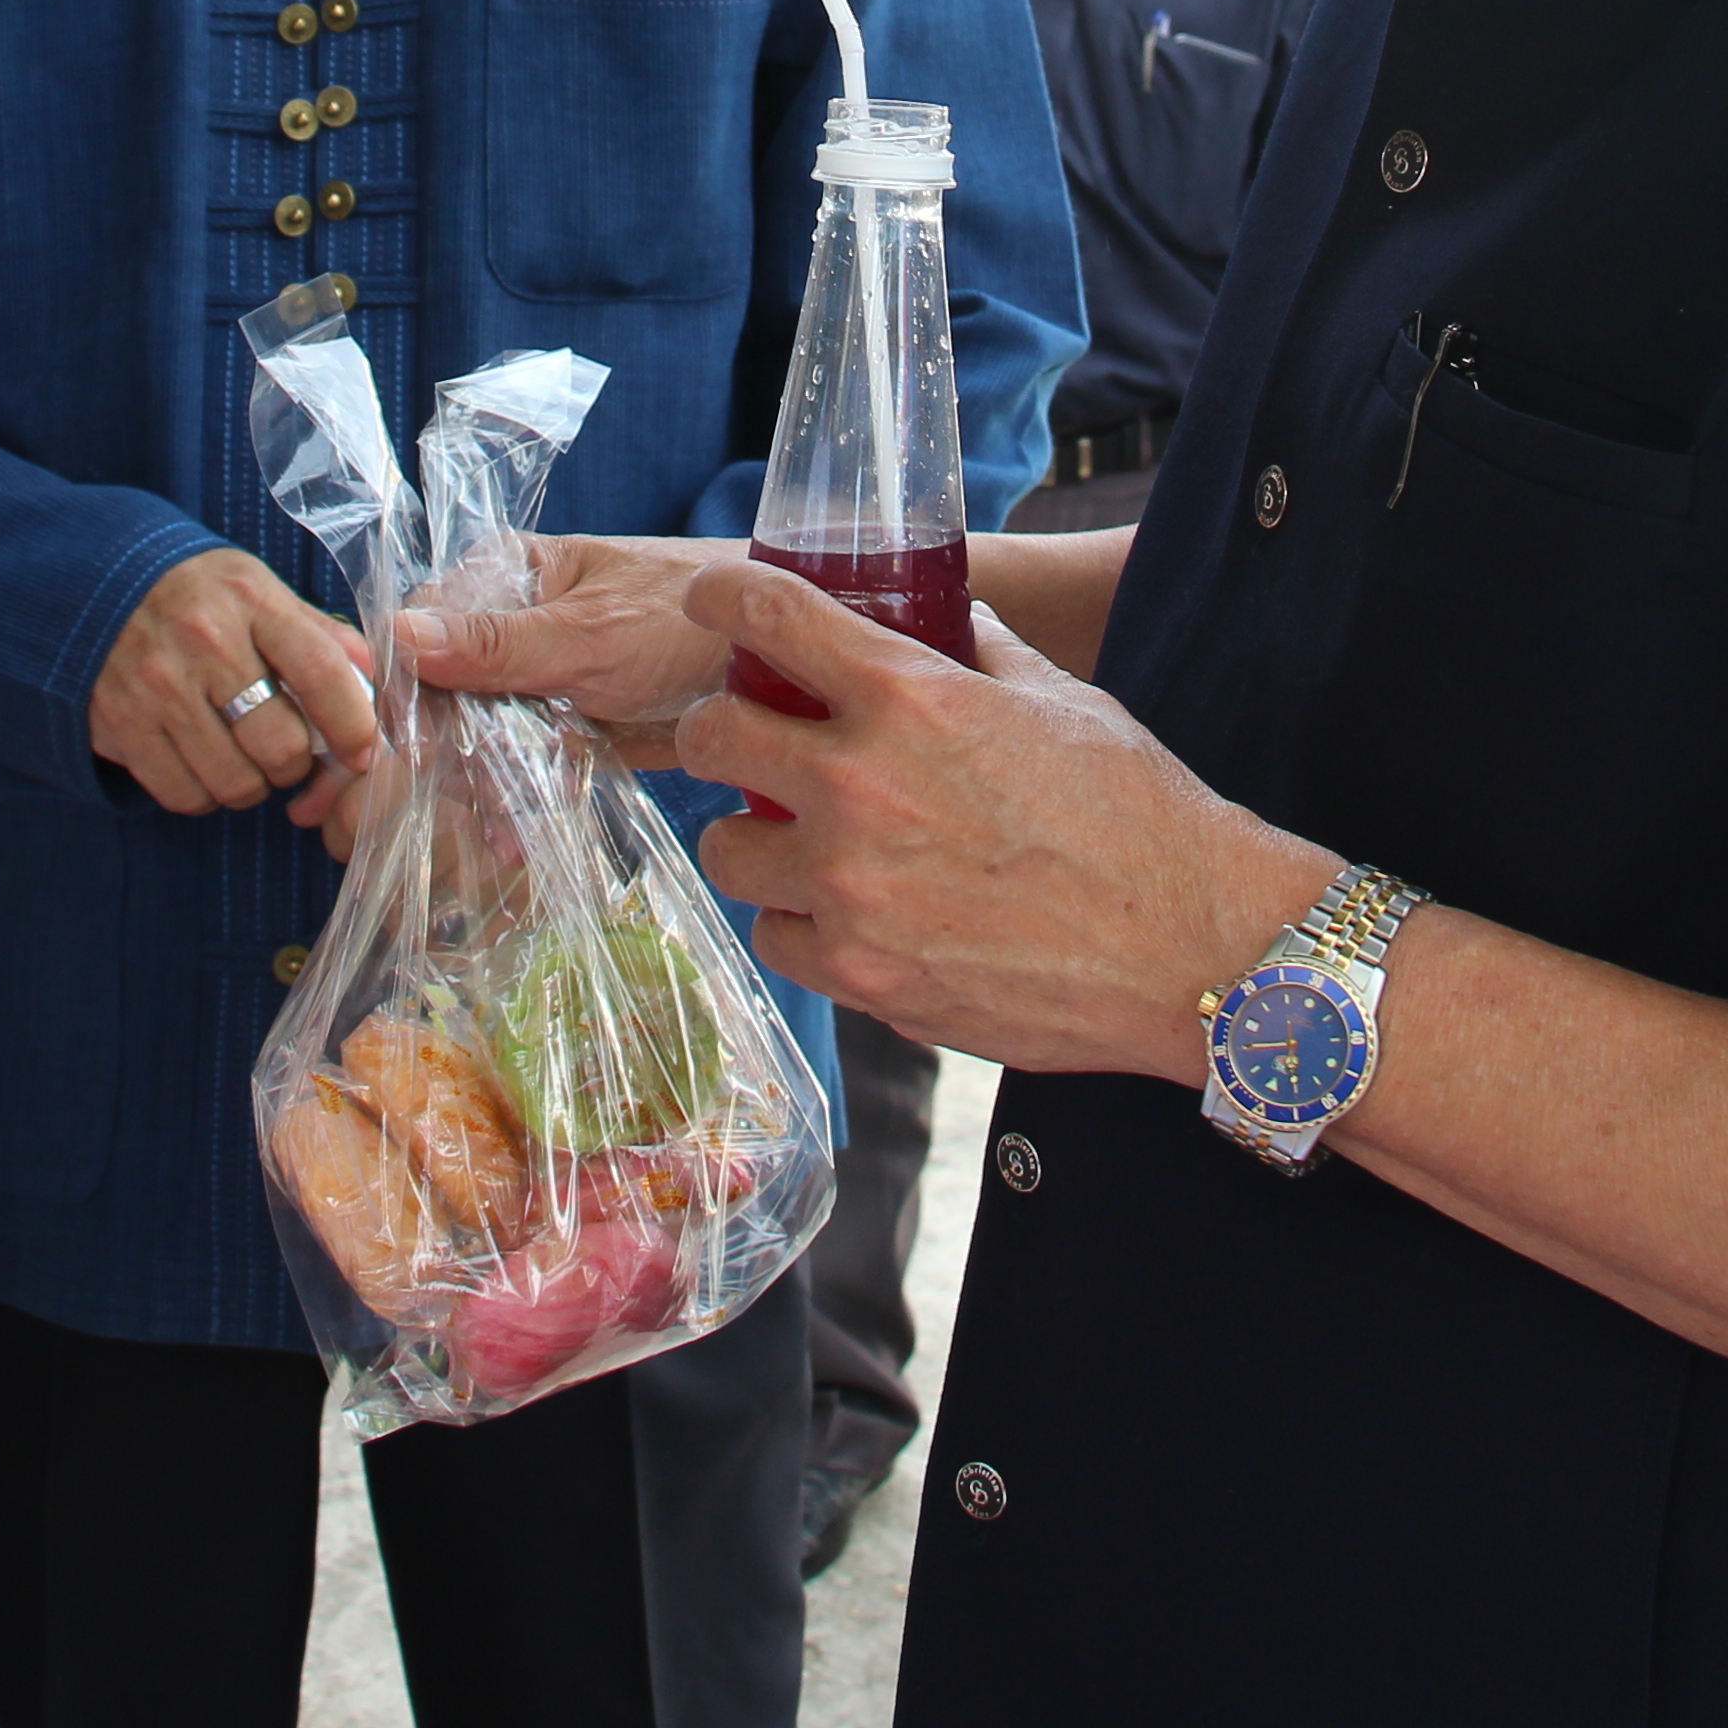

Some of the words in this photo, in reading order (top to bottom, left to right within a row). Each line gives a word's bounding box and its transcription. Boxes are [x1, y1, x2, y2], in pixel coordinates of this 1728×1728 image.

[1240, 979, 1258, 996] 20
[1308, 972, 1326, 989] 30
[1350, 1030, 1365, 1045] 40
[1214, 1045, 1227, 1057] 10
[1321, 1093, 1339, 1110] 50
